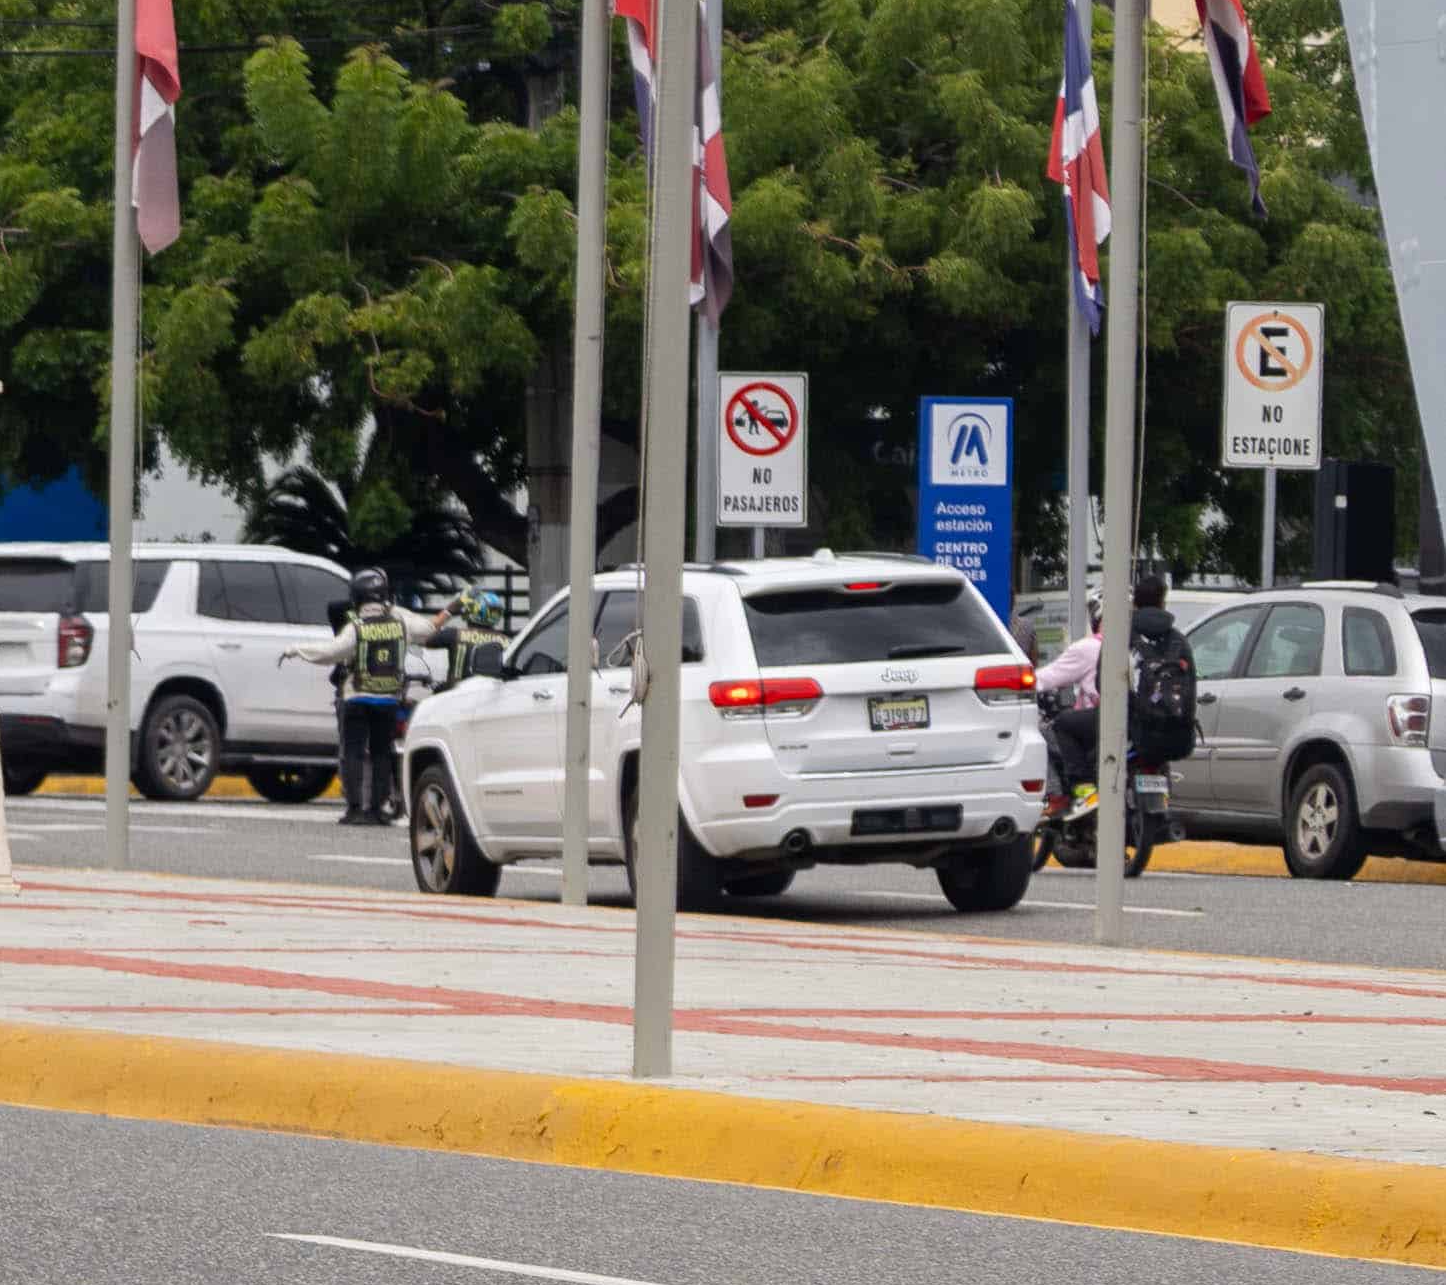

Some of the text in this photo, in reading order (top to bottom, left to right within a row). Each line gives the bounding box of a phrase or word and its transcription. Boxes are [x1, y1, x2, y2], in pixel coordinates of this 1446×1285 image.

[1262, 404, 1284, 424] NO
[1232, 435, 1311, 456] ESTACIONE
[752, 467, 773, 485] NO
[950, 469, 989, 478] METRO
[723, 495, 799, 513] PASAJEROS
[936, 501, 987, 515] Acceso
[935, 518, 993, 532] estación
[935, 541, 989, 554] CENTRO
[935, 556, 982, 568] DE LOS
[880, 667, 919, 684] Jeep
